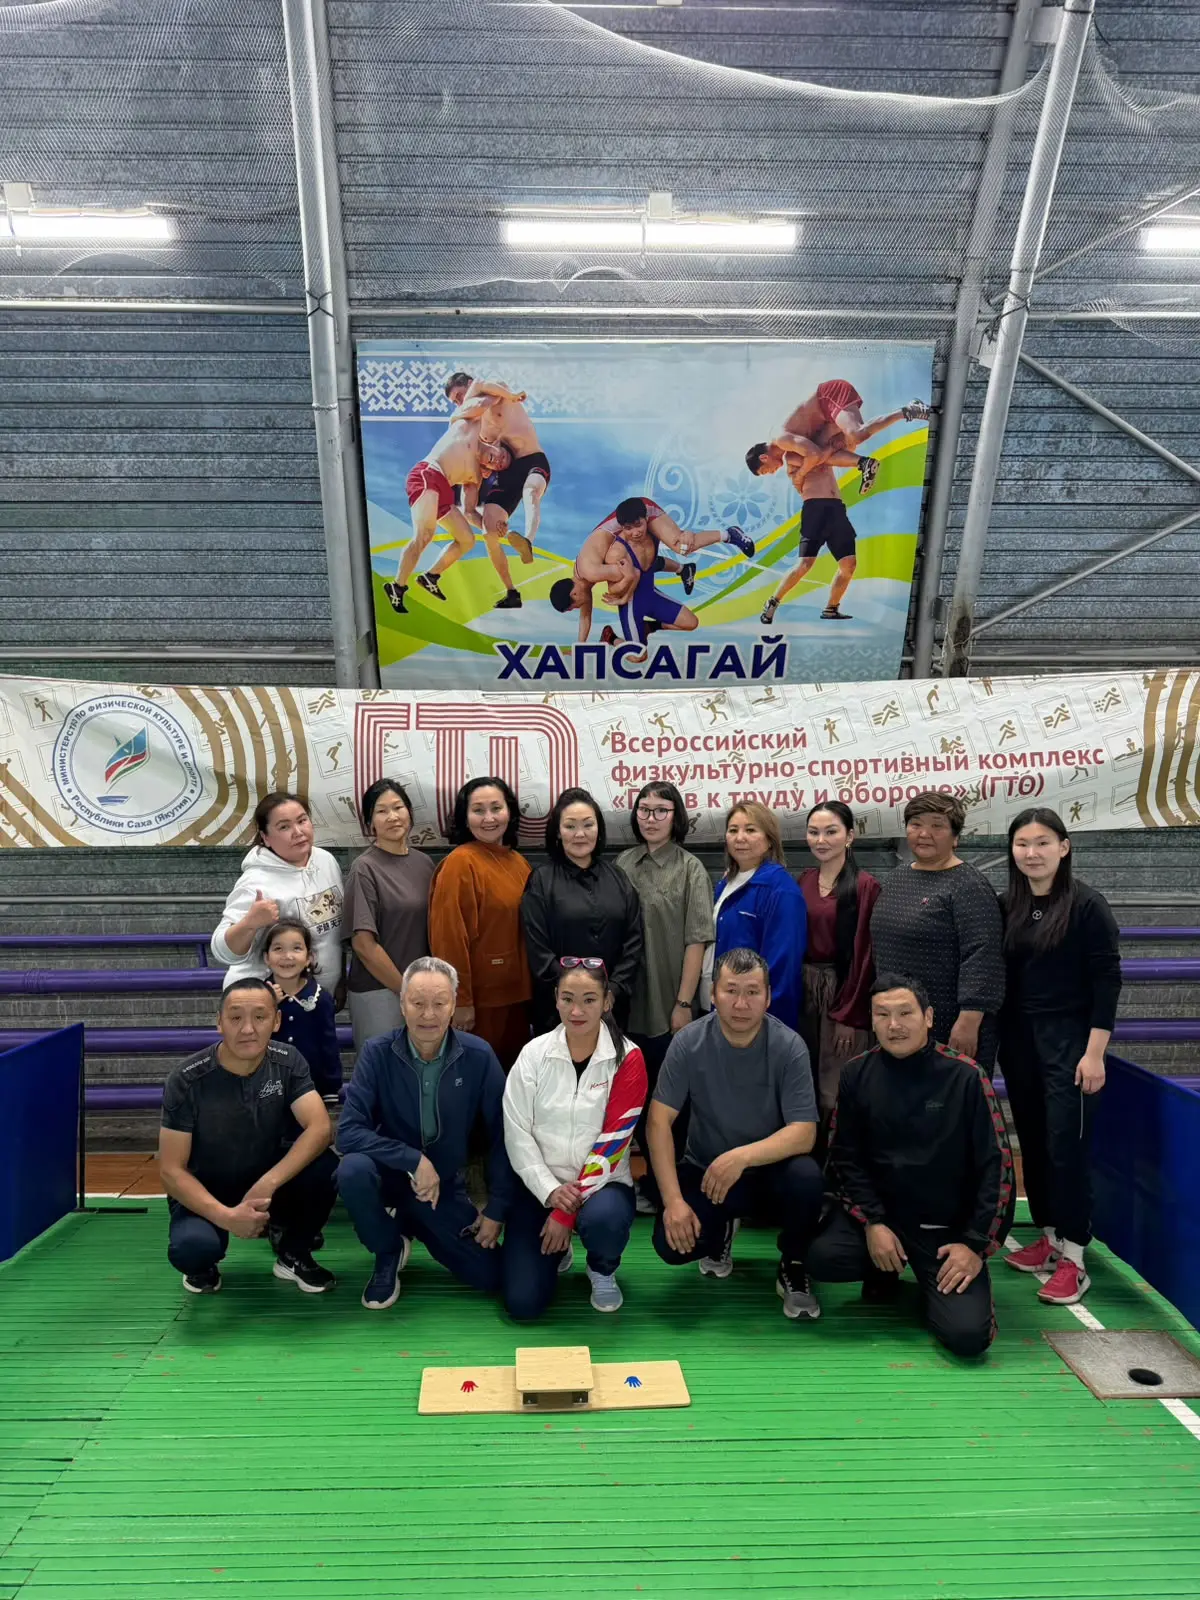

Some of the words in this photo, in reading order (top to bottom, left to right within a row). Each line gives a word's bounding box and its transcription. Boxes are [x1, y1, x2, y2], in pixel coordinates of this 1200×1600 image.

[497, 635, 787, 680] ХАПСАГАЙ
[88, 700, 153, 715] ФИЗИЧЕСКОЙ
[152, 711, 186, 751] КУЛЬТУРЕ
[180, 752, 188, 760] И
[611, 727, 808, 757] Всероссийский
[611, 748, 969, 787] физкультурно-спортивный
[979, 748, 1105, 771] комплекс
[707, 792, 721, 809] к
[813, 788, 829, 805] и
[981, 772, 1045, 801] (ГТО)
[70, 794, 125, 829] Республики
[126, 819, 153, 829] Саха
[154, 796, 192, 825] (Якутия)
